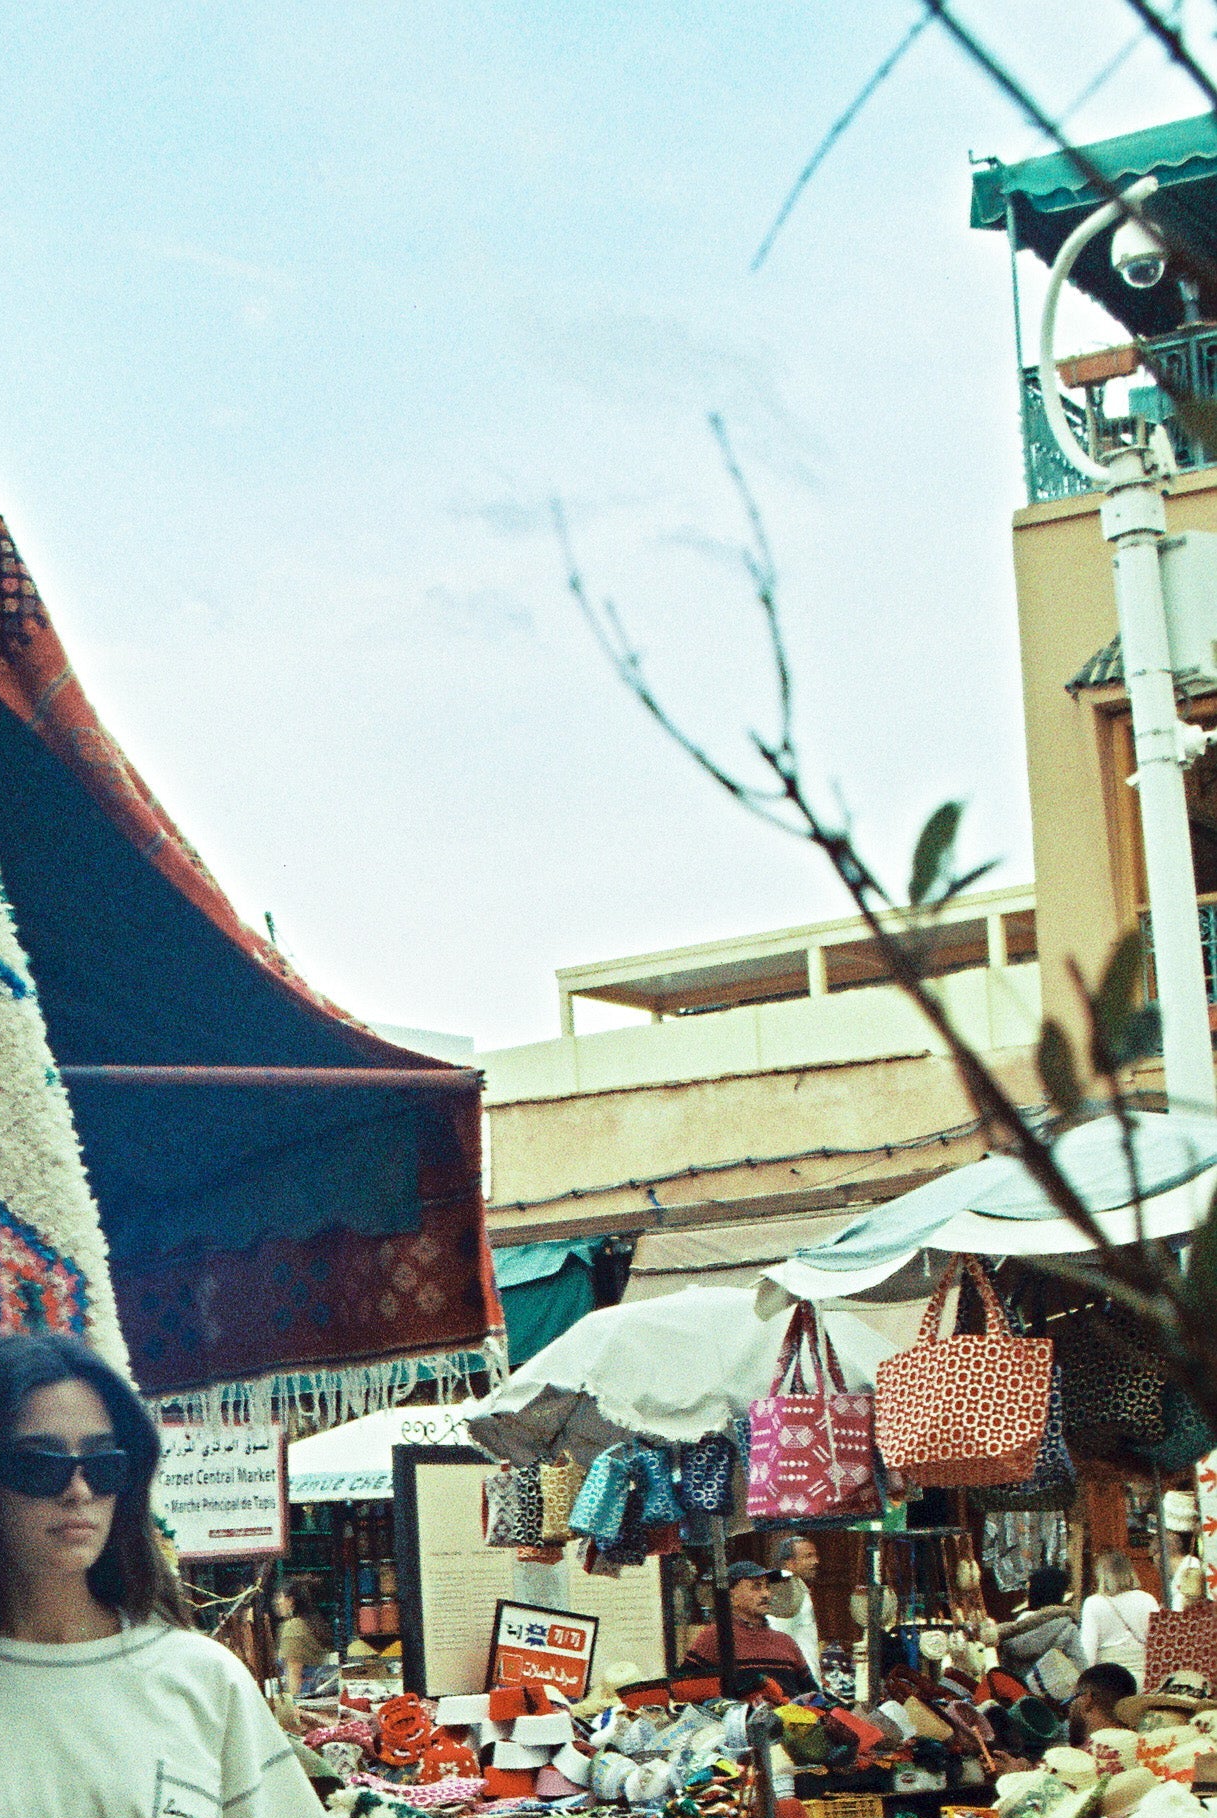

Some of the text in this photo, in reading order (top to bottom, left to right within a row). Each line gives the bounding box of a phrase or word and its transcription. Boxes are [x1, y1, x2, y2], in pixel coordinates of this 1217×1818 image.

[160, 1466, 276, 1487] Carpet Central Market
[203, 1498, 240, 1514] Principal
[241, 1496, 252, 1510] de
[253, 1495, 276, 1512] Tapis
